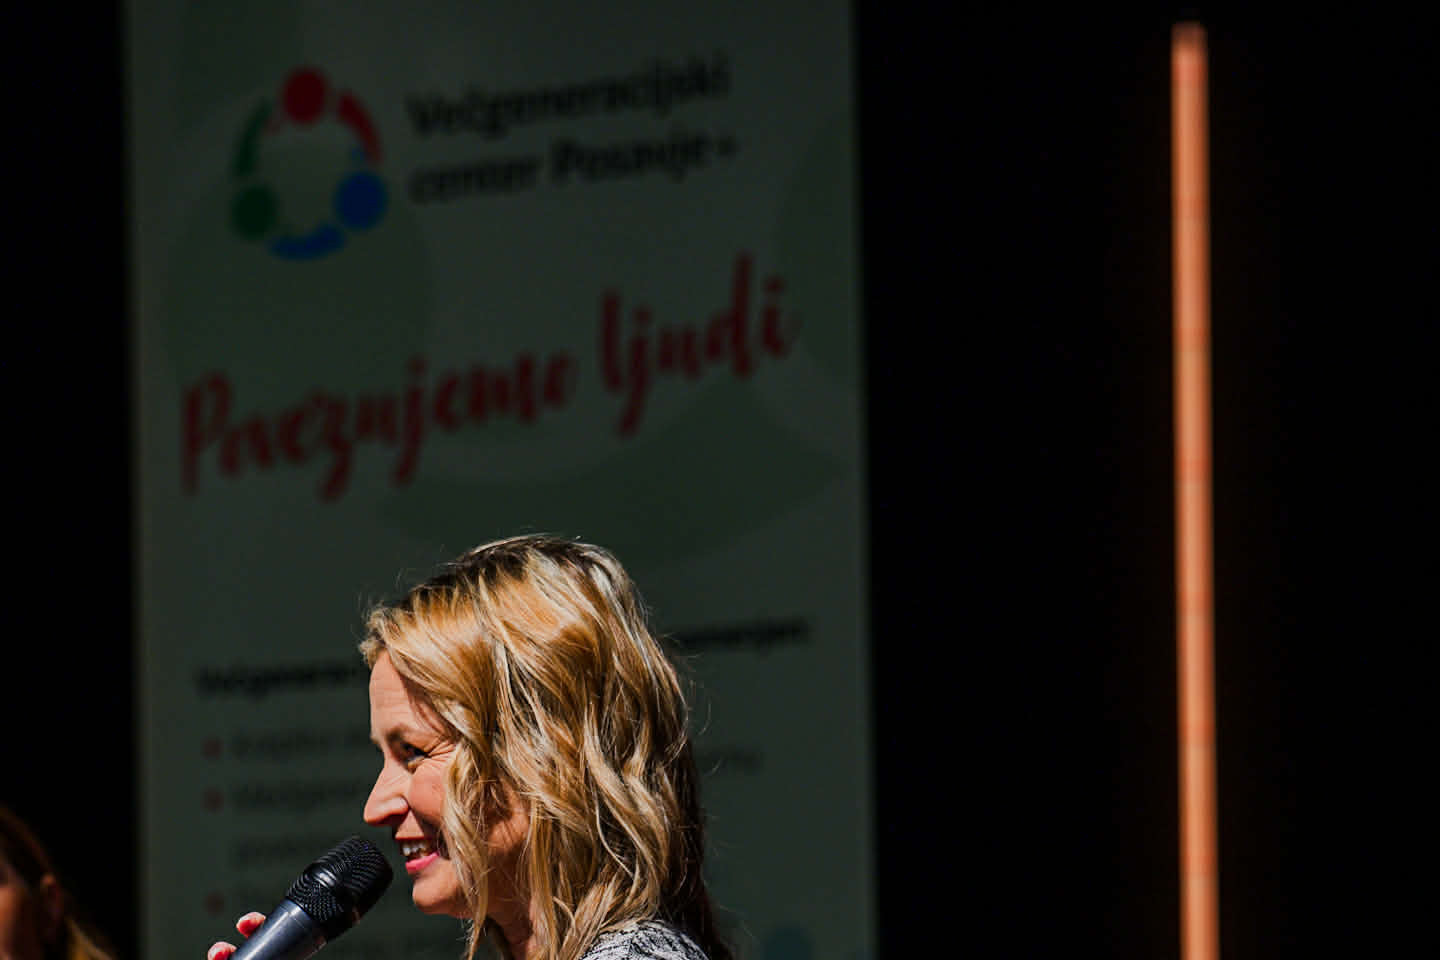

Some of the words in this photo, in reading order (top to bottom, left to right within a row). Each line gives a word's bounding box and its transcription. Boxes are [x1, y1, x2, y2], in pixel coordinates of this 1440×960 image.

[409, 57, 728, 137] Večgeneracijski
[409, 158, 540, 203] center
[183, 357, 571, 500] Povezujemo
[600, 252, 789, 436] ljudi
